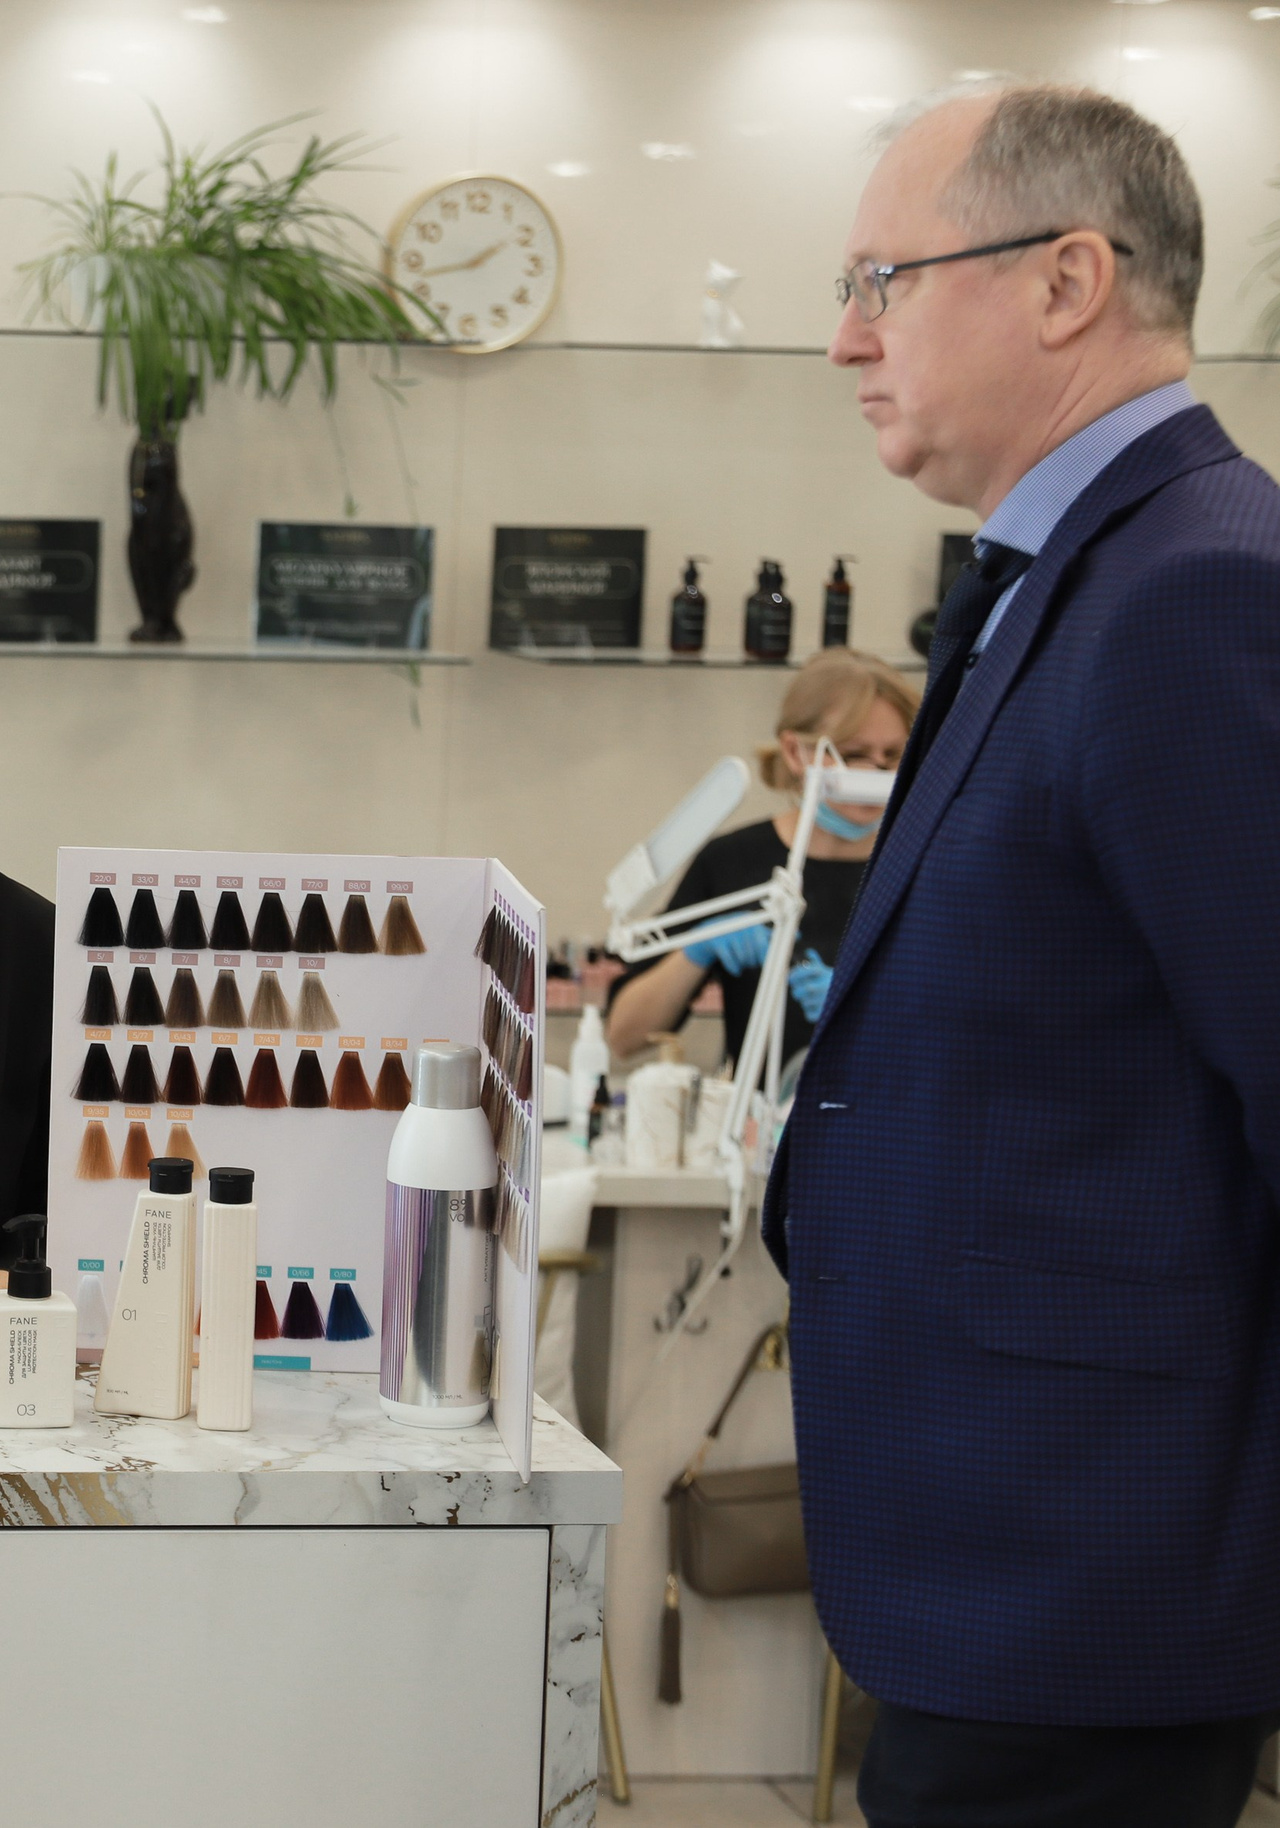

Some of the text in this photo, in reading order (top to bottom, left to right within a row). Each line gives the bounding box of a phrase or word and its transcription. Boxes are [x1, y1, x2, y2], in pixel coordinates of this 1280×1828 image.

[145, 1209, 172, 1219] FANE
[449, 1214, 465, 1222] VO
[292, 1269, 310, 1277] 0/66
[122, 1308, 137, 1321] 01
[10, 1317, 38, 1325] FANE
[17, 1404, 36, 1416] 03
